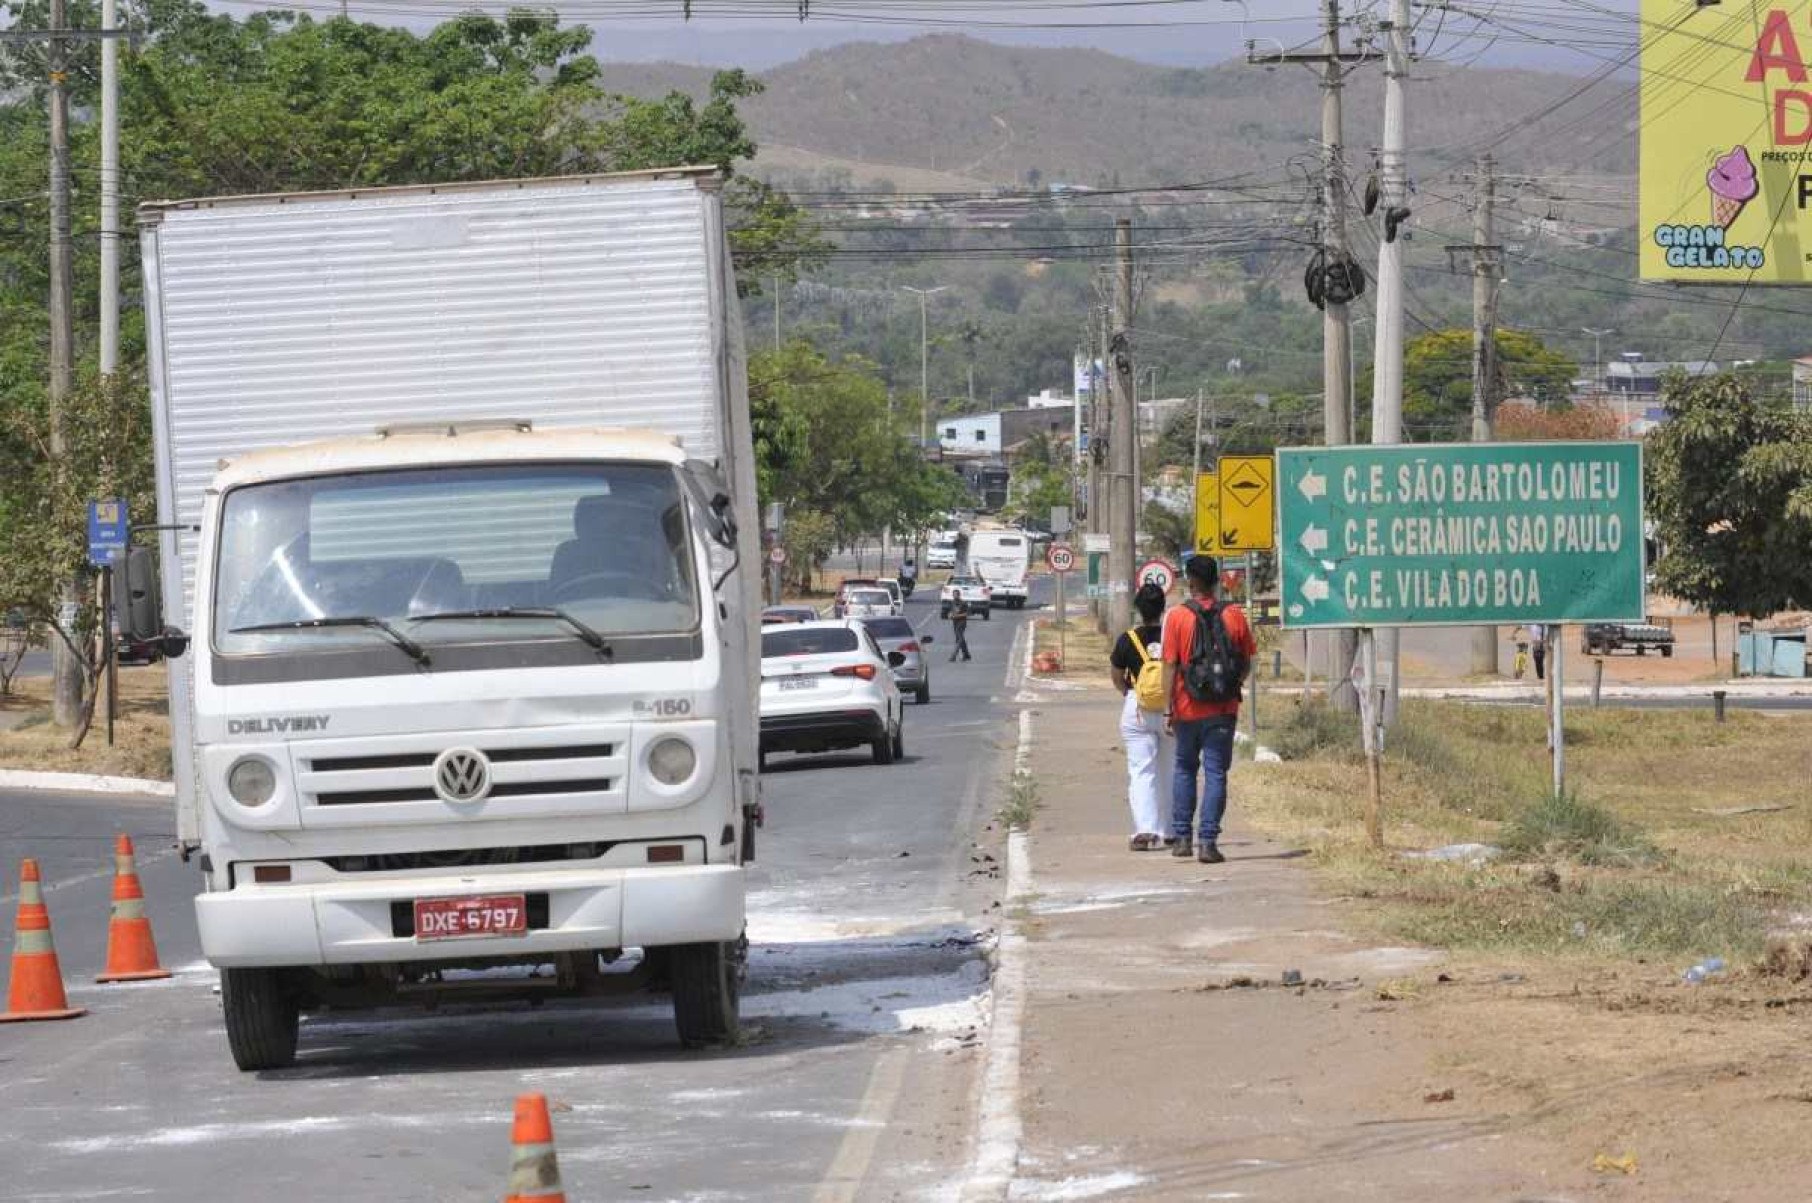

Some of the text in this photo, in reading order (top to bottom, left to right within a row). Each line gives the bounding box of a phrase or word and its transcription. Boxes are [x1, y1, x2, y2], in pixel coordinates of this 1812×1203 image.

[1745, 10, 1812, 82] A
[1655, 224, 1725, 247] GRAN
[1666, 246, 1765, 269] GELATO
[1343, 458, 1620, 504] C.E. SÃO BARTOLOMEU
[1344, 518, 1386, 557] C.E.
[1391, 507, 1501, 556] CERÂMICA
[1553, 513, 1622, 553] PAULO
[1054, 553, 1070, 564] 60
[1344, 568, 1541, 609] C.E. VILA DO BOA
[228, 714, 330, 735] DELIVERY
